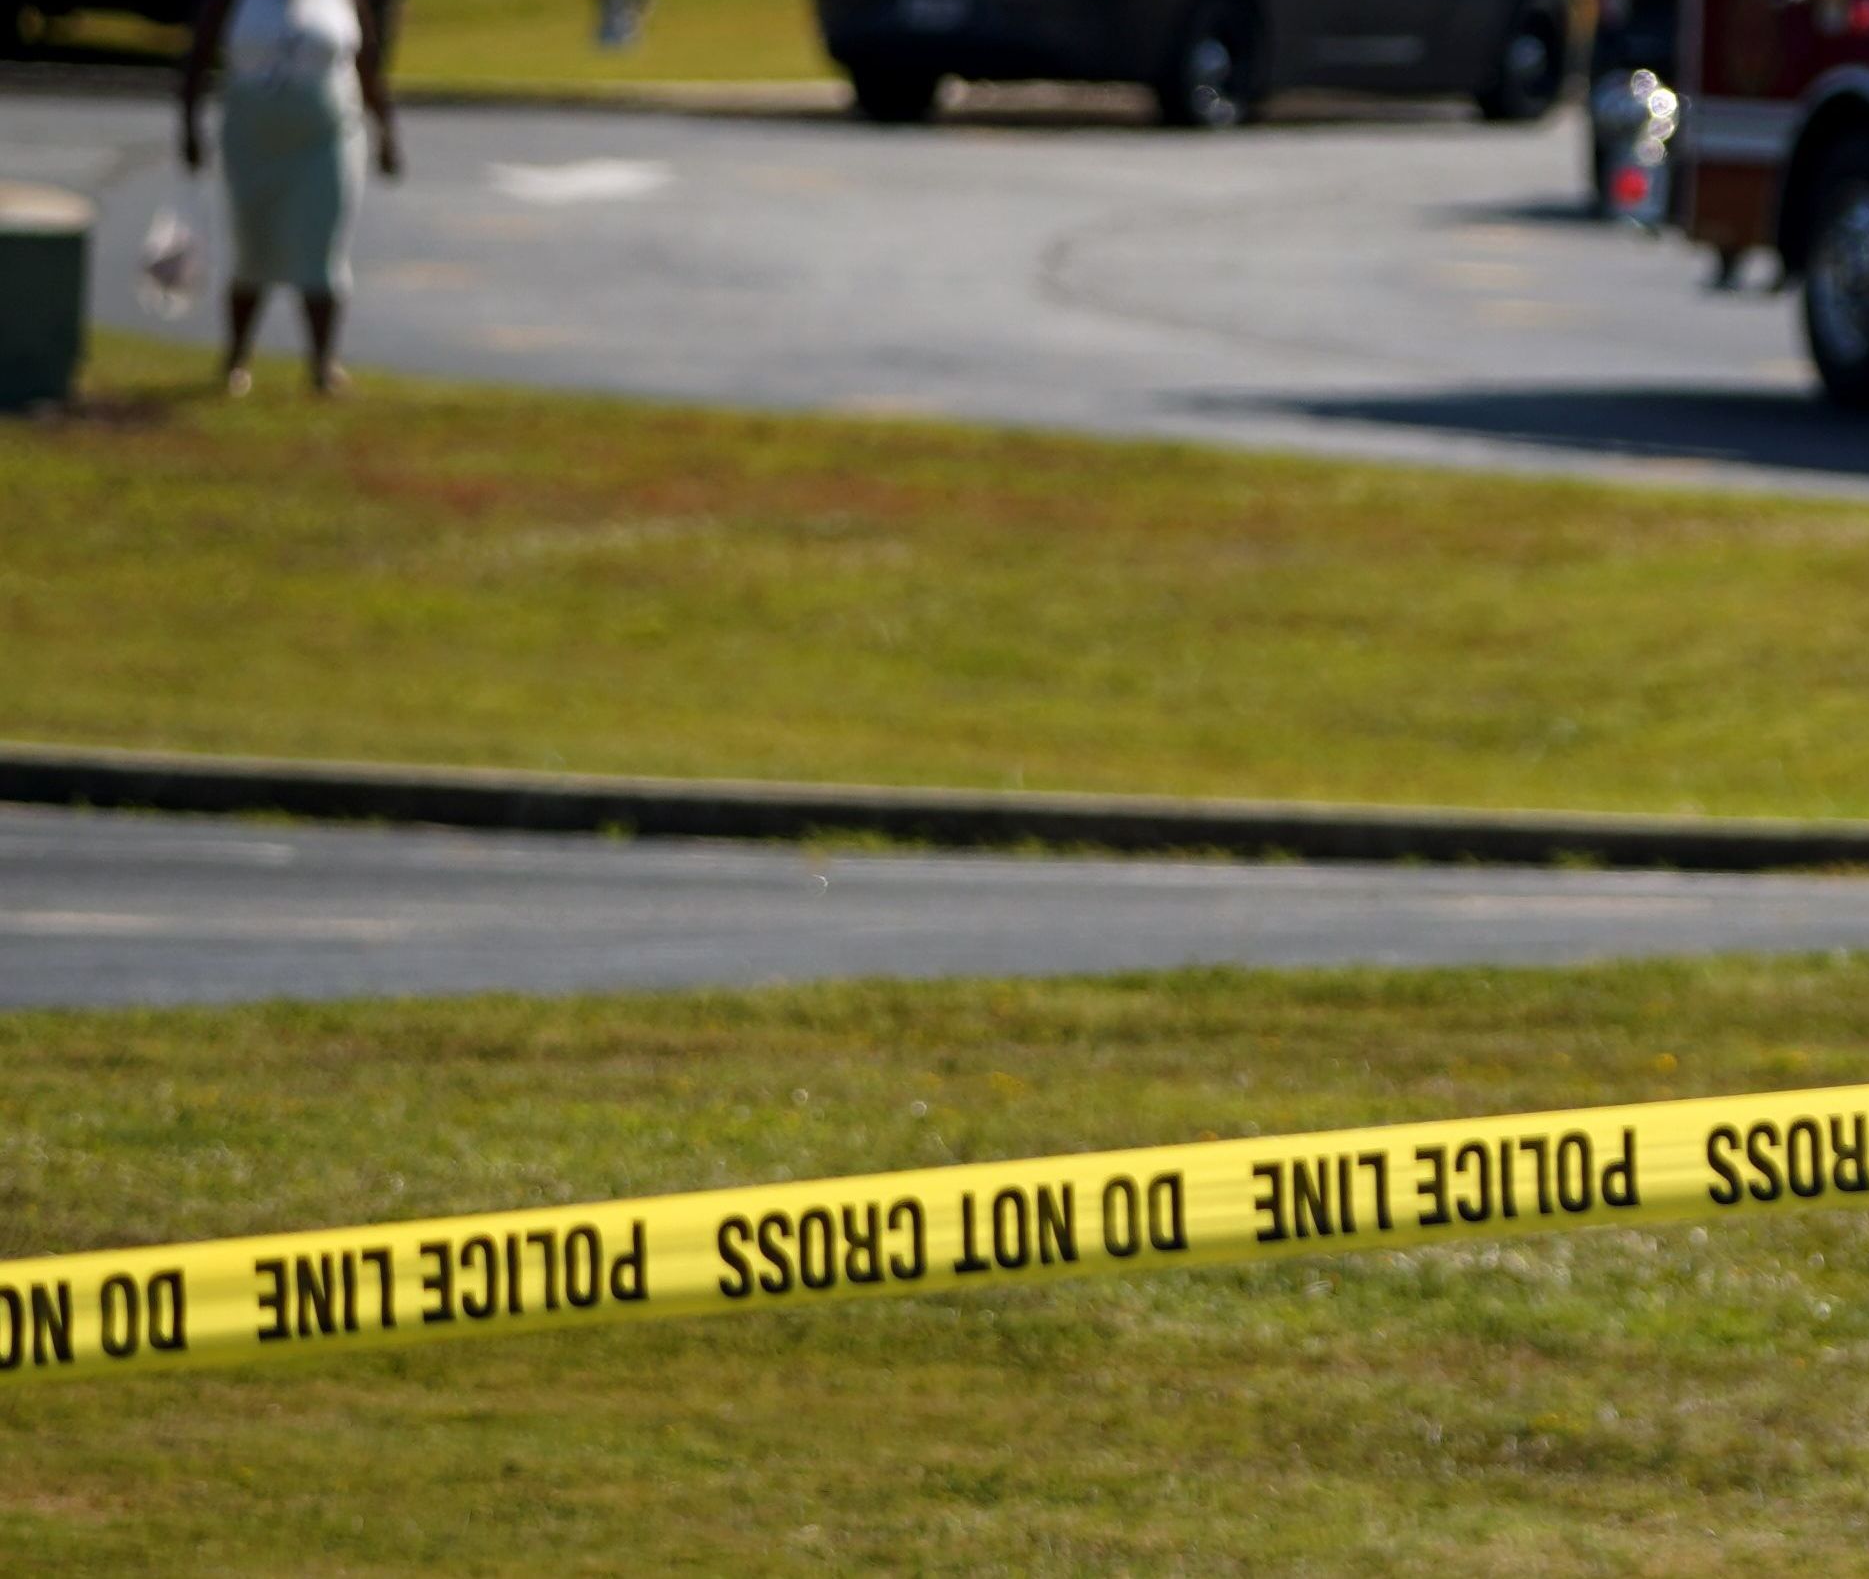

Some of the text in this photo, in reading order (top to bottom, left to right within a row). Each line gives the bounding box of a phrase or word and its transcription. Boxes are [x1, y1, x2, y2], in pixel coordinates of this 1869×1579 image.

[717, 1172, 1188, 1300] DO NOT CROSS
[1252, 1129, 1641, 1244] POLICE LINE
[100, 1269, 187, 1360] DO
[255, 1222, 649, 1343] POLICE LINE
